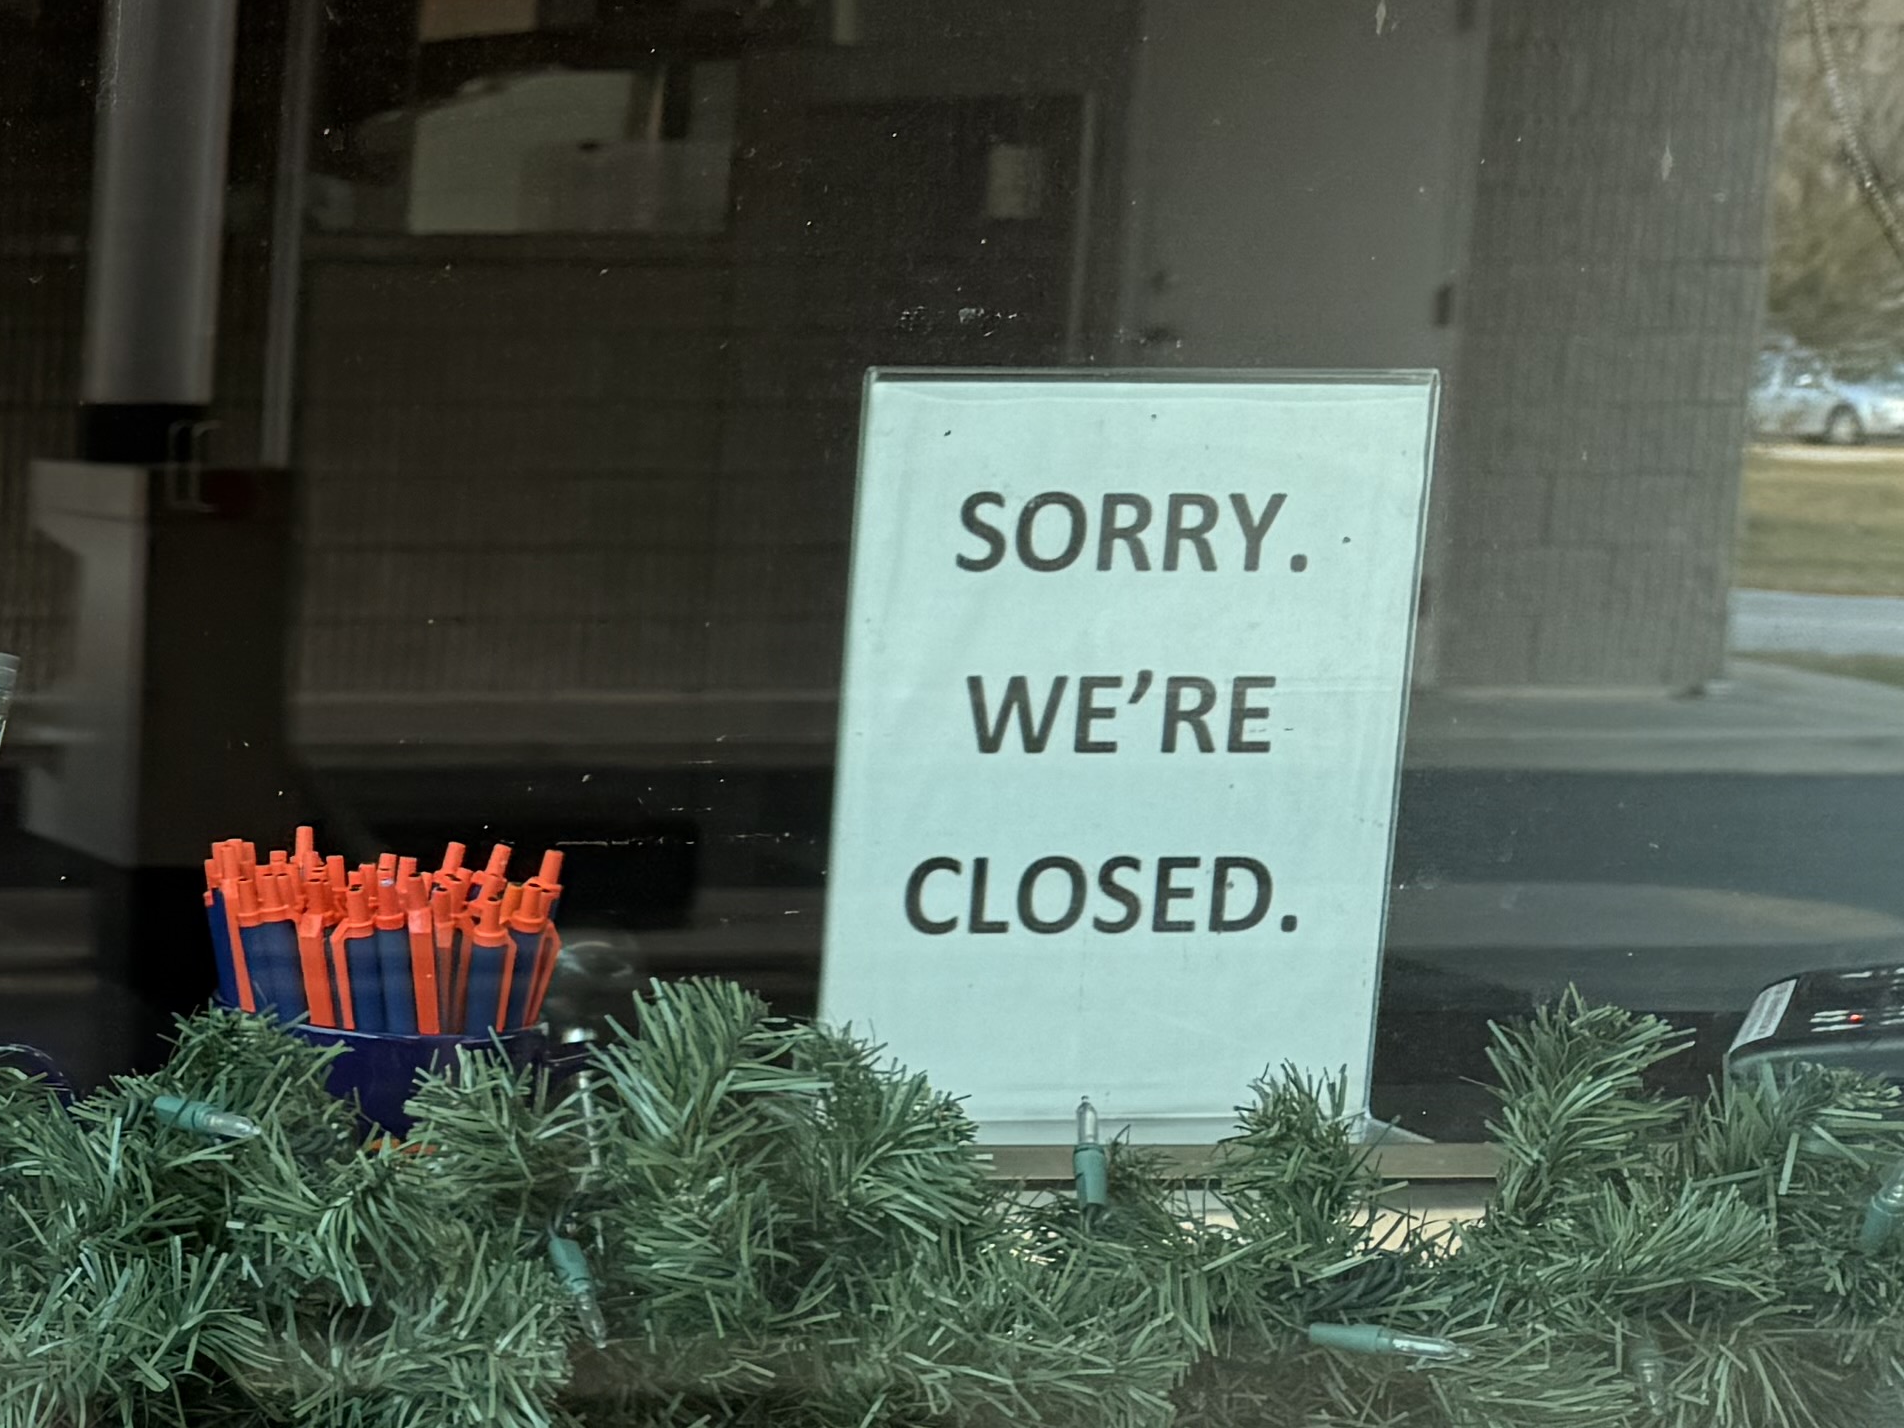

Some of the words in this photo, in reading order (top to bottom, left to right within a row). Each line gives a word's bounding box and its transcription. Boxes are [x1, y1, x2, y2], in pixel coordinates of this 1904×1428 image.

[955, 490, 1309, 573] SORRY.
[965, 669, 1277, 755] WE'RE
[903, 855, 1298, 935] CLOSED.
